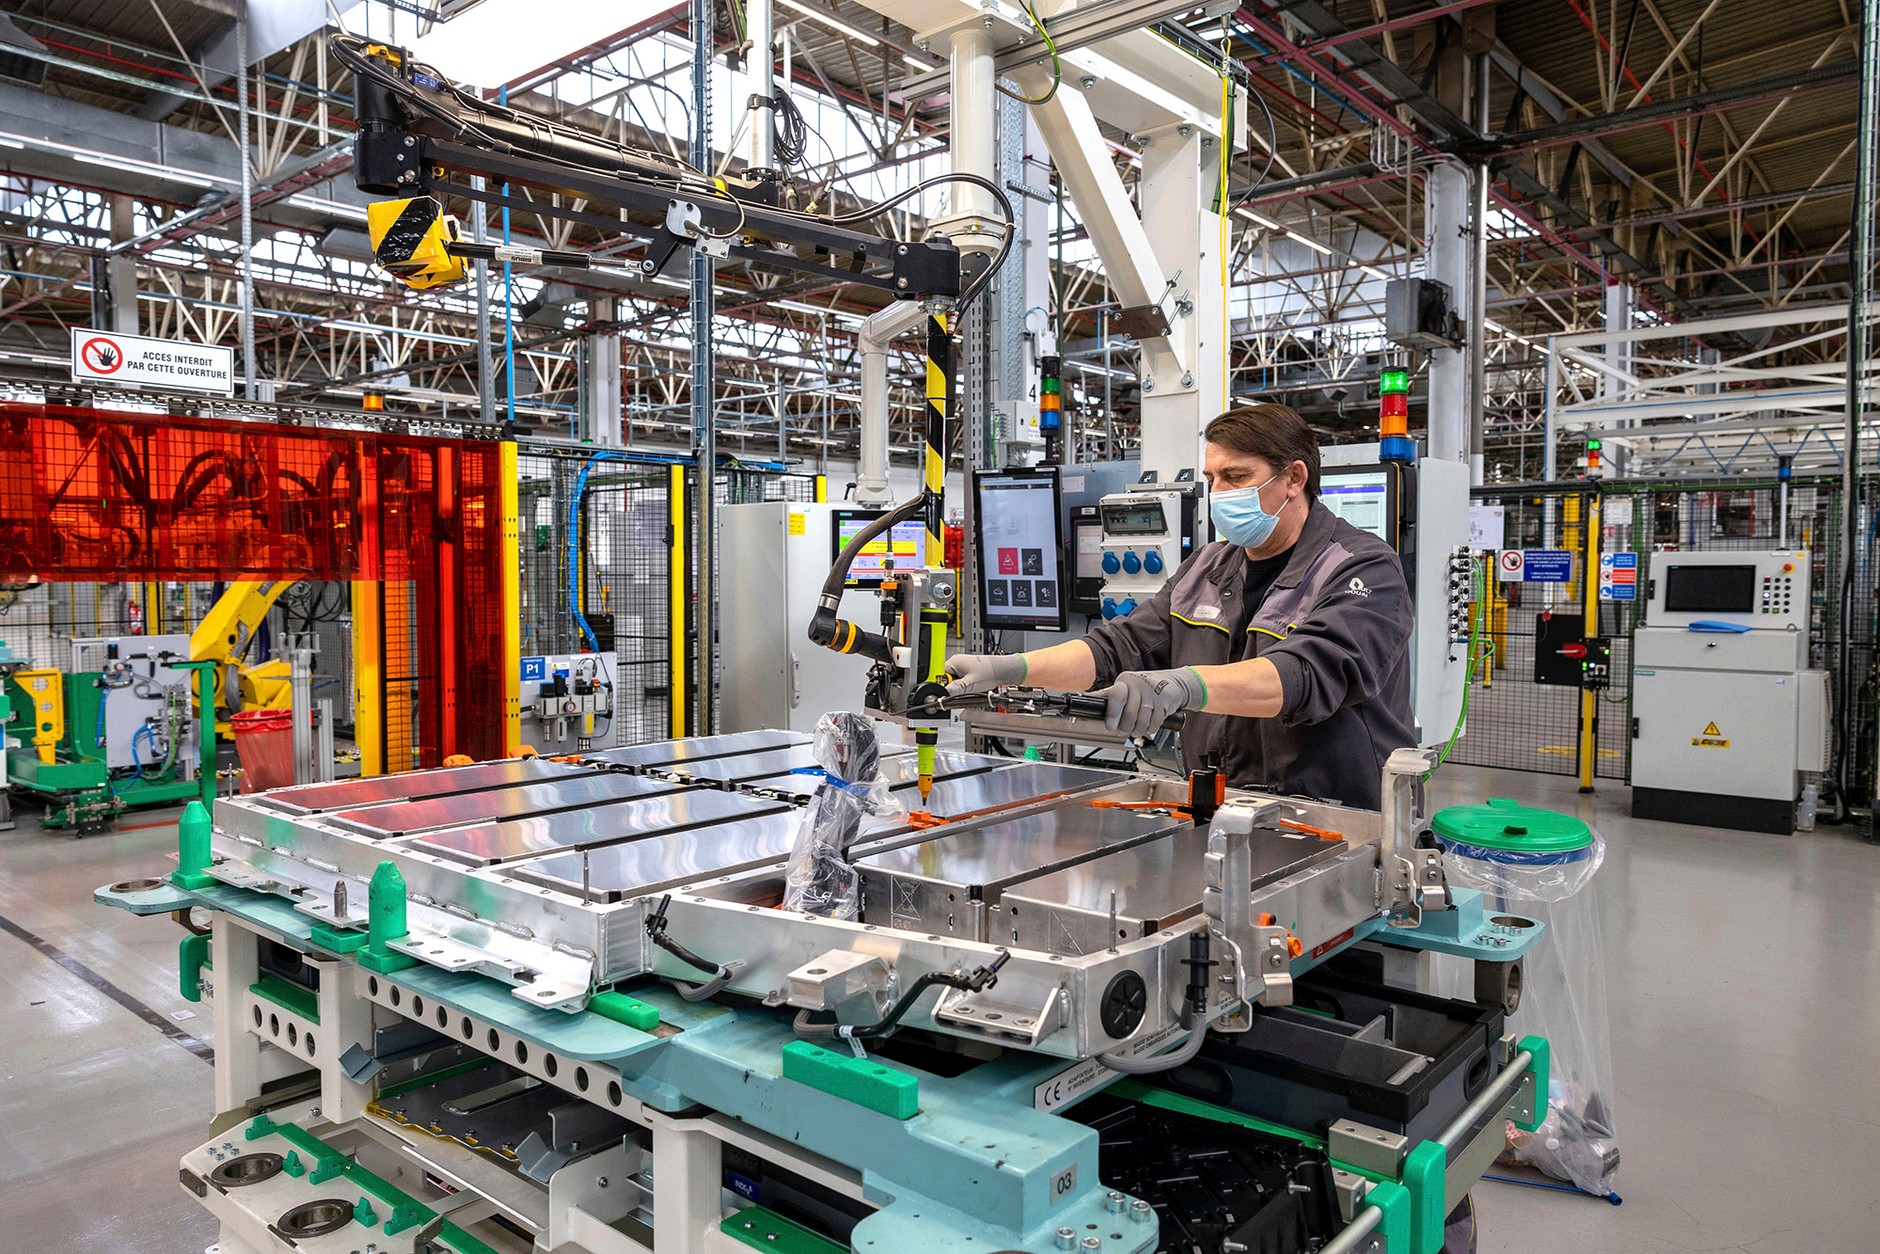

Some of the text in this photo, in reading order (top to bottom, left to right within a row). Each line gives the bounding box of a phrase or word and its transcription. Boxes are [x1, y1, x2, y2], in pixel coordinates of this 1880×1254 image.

[142, 351, 213, 367] ACCES INTERDIT
[127, 361, 227, 379] PAR CETTE OUVERTURE
[1028, 383, 1036, 402] 4
[526, 664, 538, 674] P1
[1044, 1081, 1061, 1106] CE
[1057, 1172, 1072, 1194] 03
